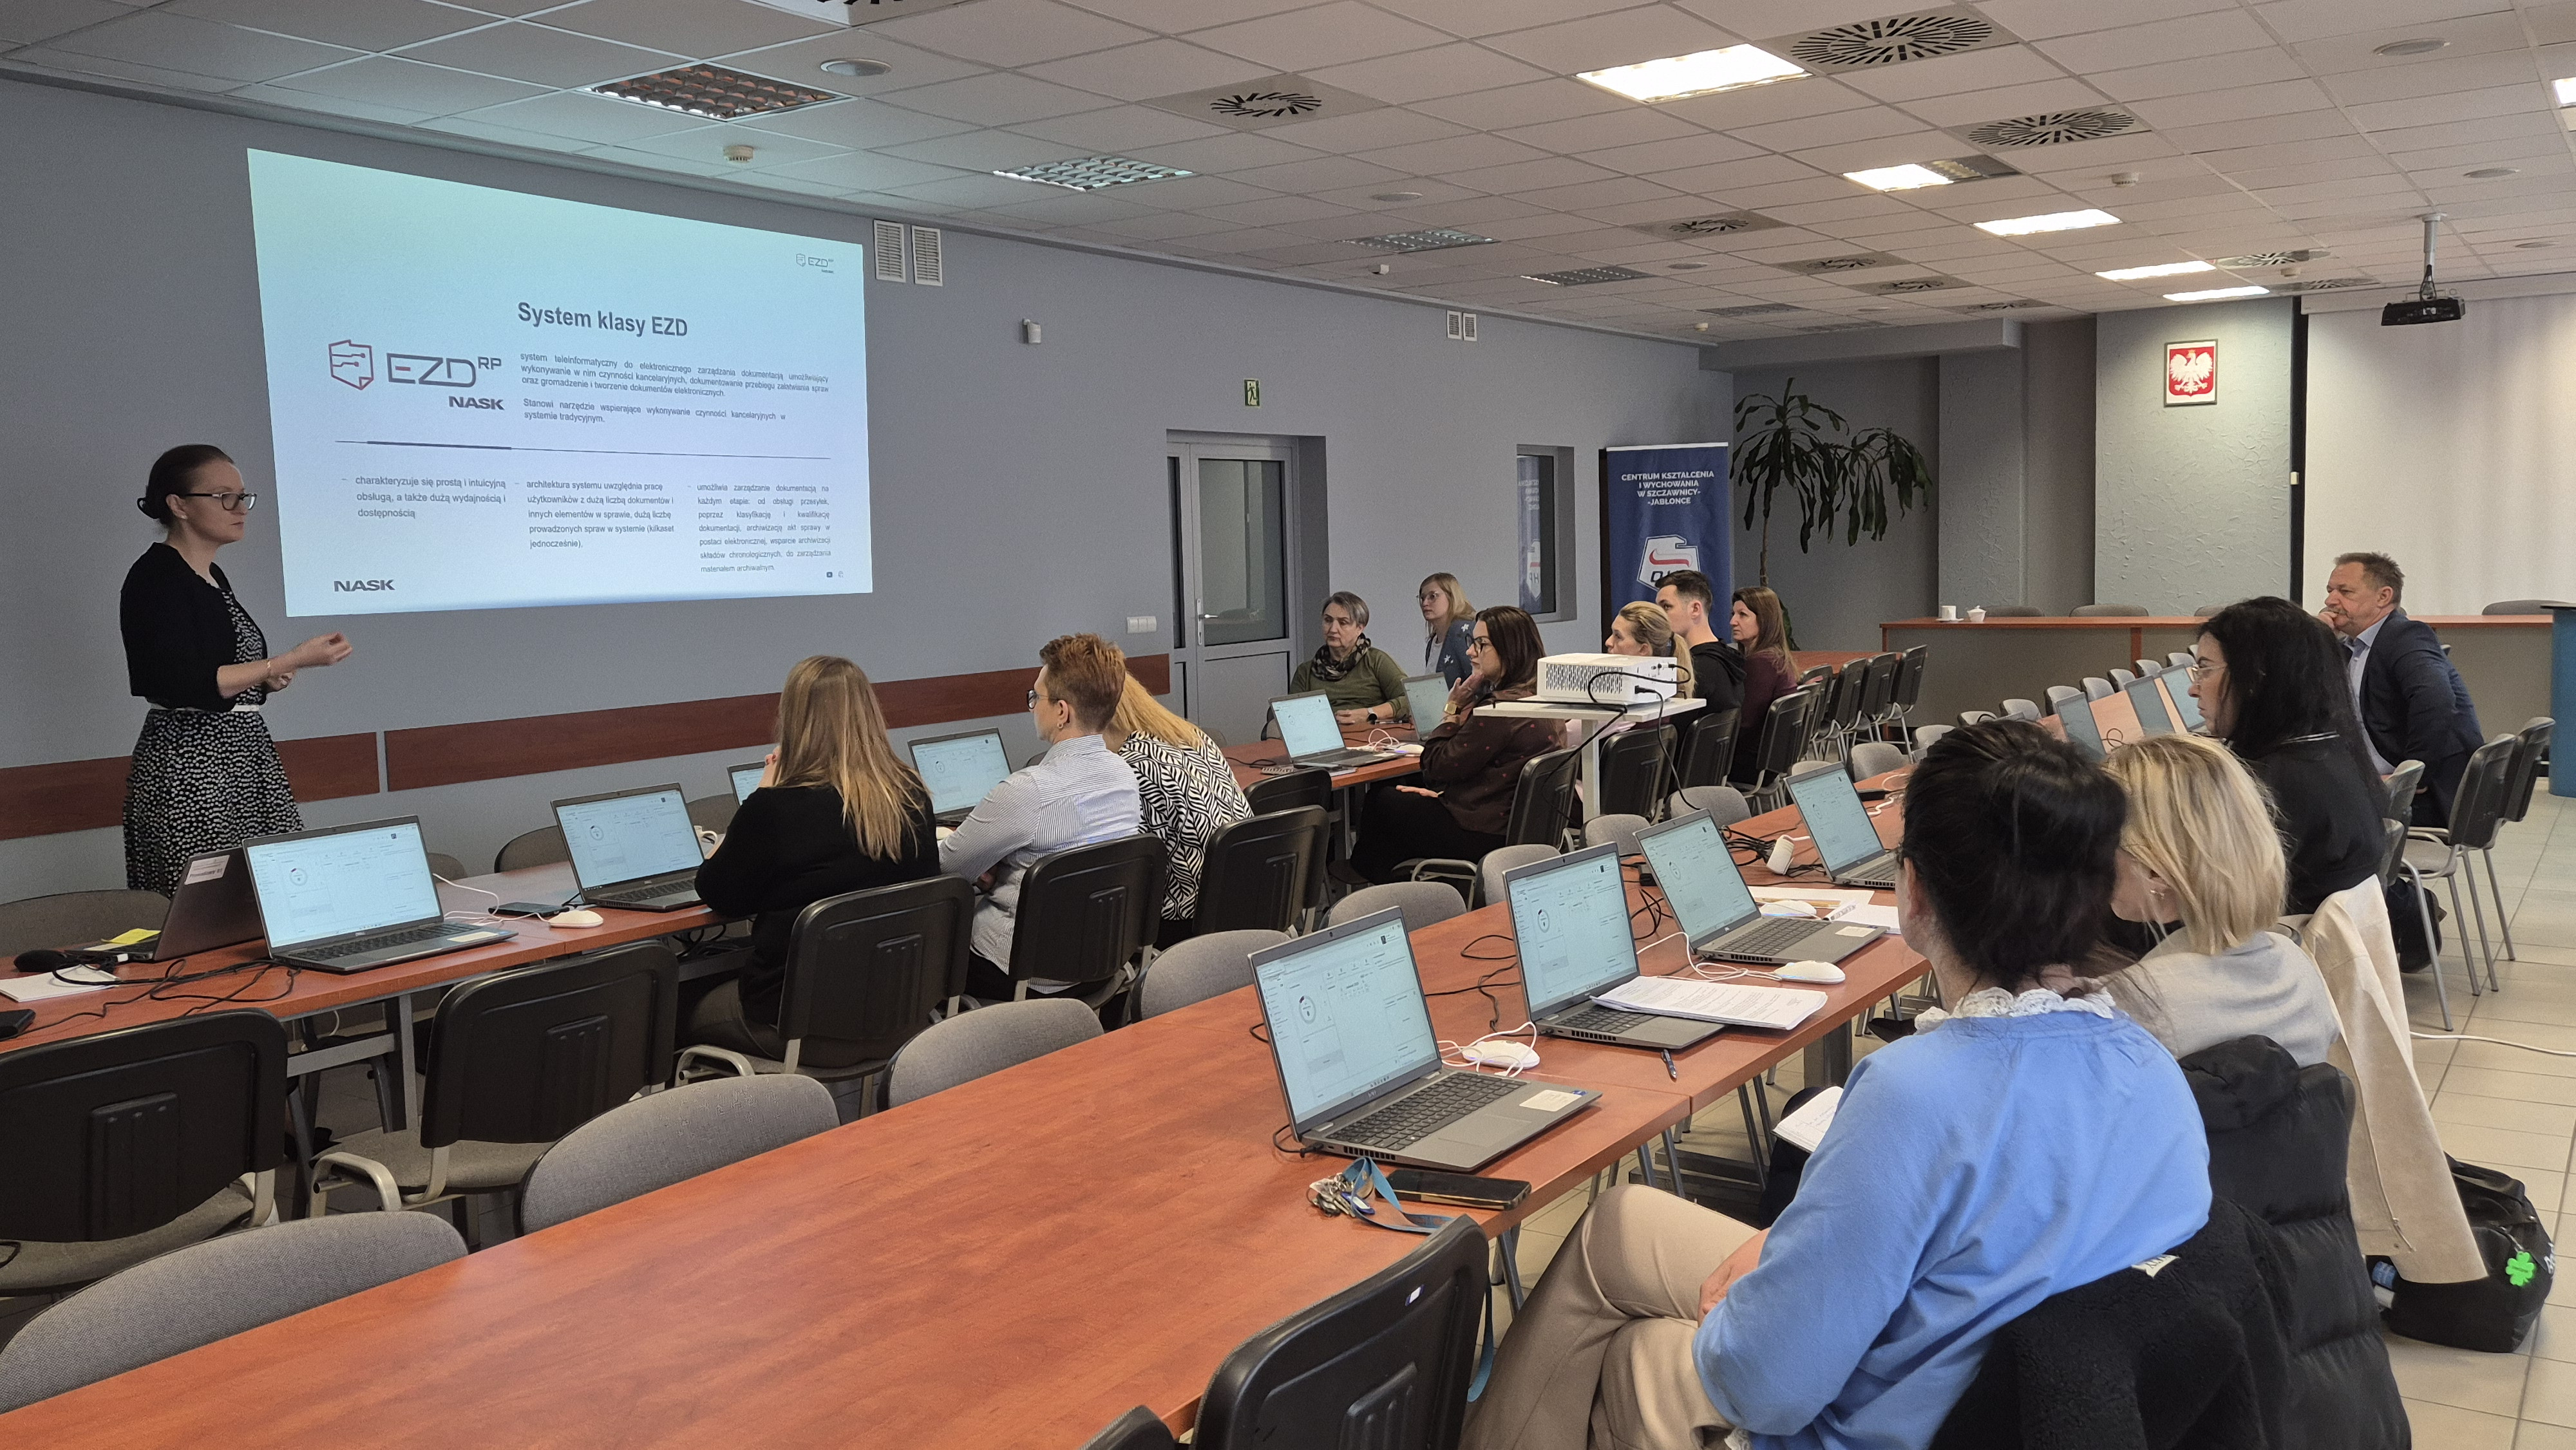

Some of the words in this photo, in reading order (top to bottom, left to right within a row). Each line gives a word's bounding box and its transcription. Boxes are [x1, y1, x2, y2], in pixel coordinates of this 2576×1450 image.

[808, 256, 828, 267] EZD
[518, 301, 591, 328] System
[598, 310, 645, 337] klasy
[652, 317, 688, 337] EZD
[386, 353, 477, 388] EZD
[478, 356, 502, 371] RP
[520, 353, 547, 363] system
[554, 355, 618, 368] teleinformatyczny
[639, 362, 692, 373] elektronicznego
[697, 367, 735, 377] zarządzania
[521, 364, 571, 376] wykonywanie
[599, 371, 634, 380] czynności
[636, 372, 687, 384] kancelaryjnych,
[690, 377, 743, 388] dokumentowanie
[745, 380, 775, 390] przebiegu
[541, 379, 589, 389] gromadzenie
[595, 381, 628, 390] tworzenie
[630, 384, 672, 394] dokumentów
[674, 388, 726, 397] elektronicznych.
[449, 396, 504, 410] NASK
[523, 398, 554, 408] Stanowi
[559, 402, 595, 411] narzędzie
[600, 404, 641, 415] wspierające
[647, 406, 691, 417] wykonywanie
[696, 410, 726, 419] czynności
[731, 411, 775, 421] kancelaryjnych
[524, 411, 558, 420] systemie
[560, 413, 605, 423] tradycyjnym.
[1622, 473, 1660, 481] CENTRUM
[1662, 471, 1714, 479] KSZTAŁCENIA
[355, 475, 419, 487] charakteryzuje
[421, 477, 433, 488] się
[436, 478, 462, 488] prostą
[469, 478, 506, 489] intuicyjną
[526, 480, 570, 489] architektura
[572, 482, 602, 491] systemu
[604, 482, 642, 492] uwzględnia
[644, 483, 663, 492] pracę
[1642, 480, 1699, 489] WYCHOWANIA
[734, 484, 770, 493] zarządzanie
[775, 484, 817, 493] dokumentacją
[1647, 488, 1701, 497] SZCZAWNICY-
[357, 493, 394, 503] obsługą,
[404, 493, 428, 502] także
[430, 493, 450, 504] dużą
[452, 493, 501, 504] wydajnością
[527, 495, 578, 505] użytkowników
[587, 496, 604, 505] dużą
[605, 496, 626, 505] liczbą
[627, 496, 670, 505] dokumentów
[698, 497, 723, 506] każdym
[729, 498, 750, 506] etapie:
[773, 497, 794, 506] obsługi
[1647, 497, 1691, 505] -JABŁONCE
[358, 509, 416, 519] dostępnością
[528, 510, 553, 519] innych
[554, 510, 594, 518] elementów
[604, 510, 632, 520] sprawie,
[634, 511, 650, 520] dużą
[652, 511, 671, 520] liczbę
[529, 524, 582, 534] prowadzonych
[584, 526, 605, 534] spraw
[615, 525, 645, 534] systemie
[647, 524, 674, 534] (kilkaset
[529, 540, 583, 549] jednocześnie),
[770, 537, 796, 545] wsparcie
[334, 579, 395, 592] NASK
